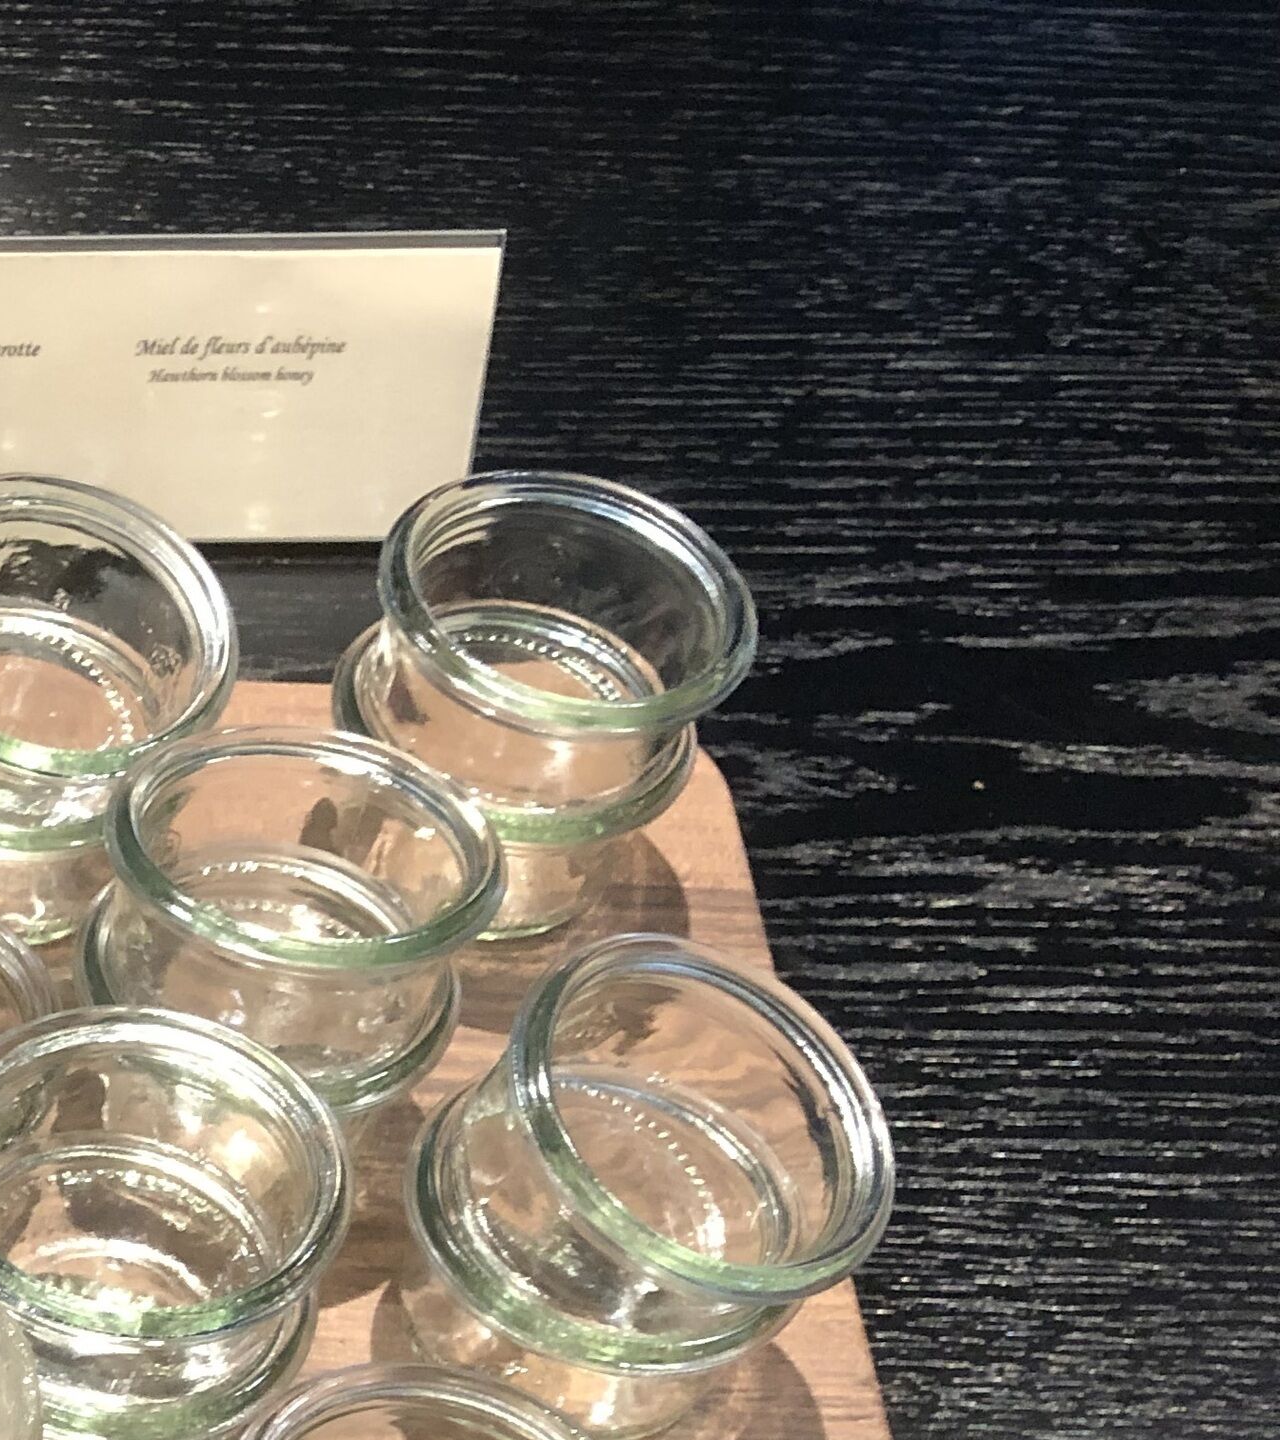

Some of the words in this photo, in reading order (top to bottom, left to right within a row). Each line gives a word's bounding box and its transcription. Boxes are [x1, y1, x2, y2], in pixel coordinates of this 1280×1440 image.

[135, 336, 180, 356] Miel
[180, 336, 199, 355] de
[197, 336, 251, 360] fleurs
[147, 367, 218, 383] Hawthorn
[221, 366, 273, 382] blossom
[274, 366, 314, 386] honey
